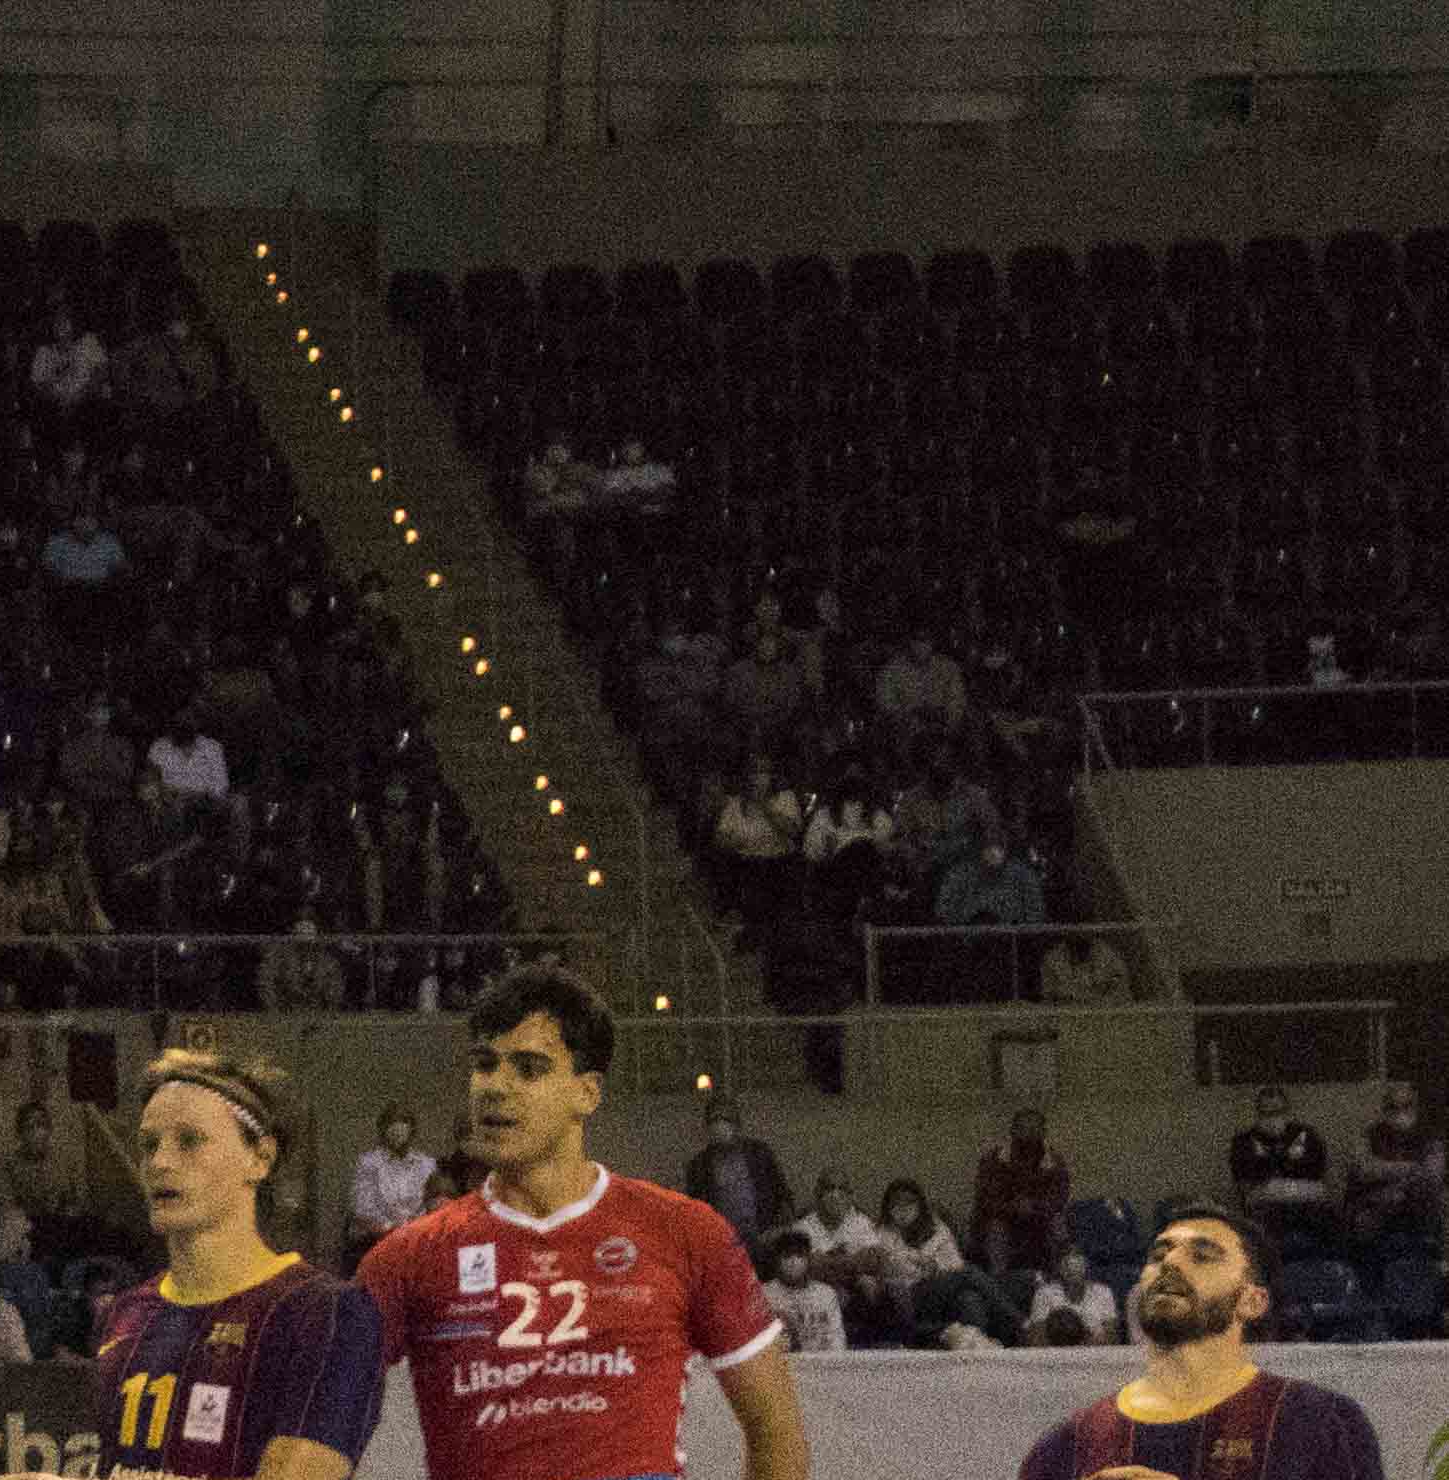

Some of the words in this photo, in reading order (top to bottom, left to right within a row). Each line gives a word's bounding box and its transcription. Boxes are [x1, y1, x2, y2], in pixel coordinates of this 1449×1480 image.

[497, 1279, 590, 1349] 22
[451, 1344, 636, 1397] Liberbank
[118, 1371, 178, 1450] 11
